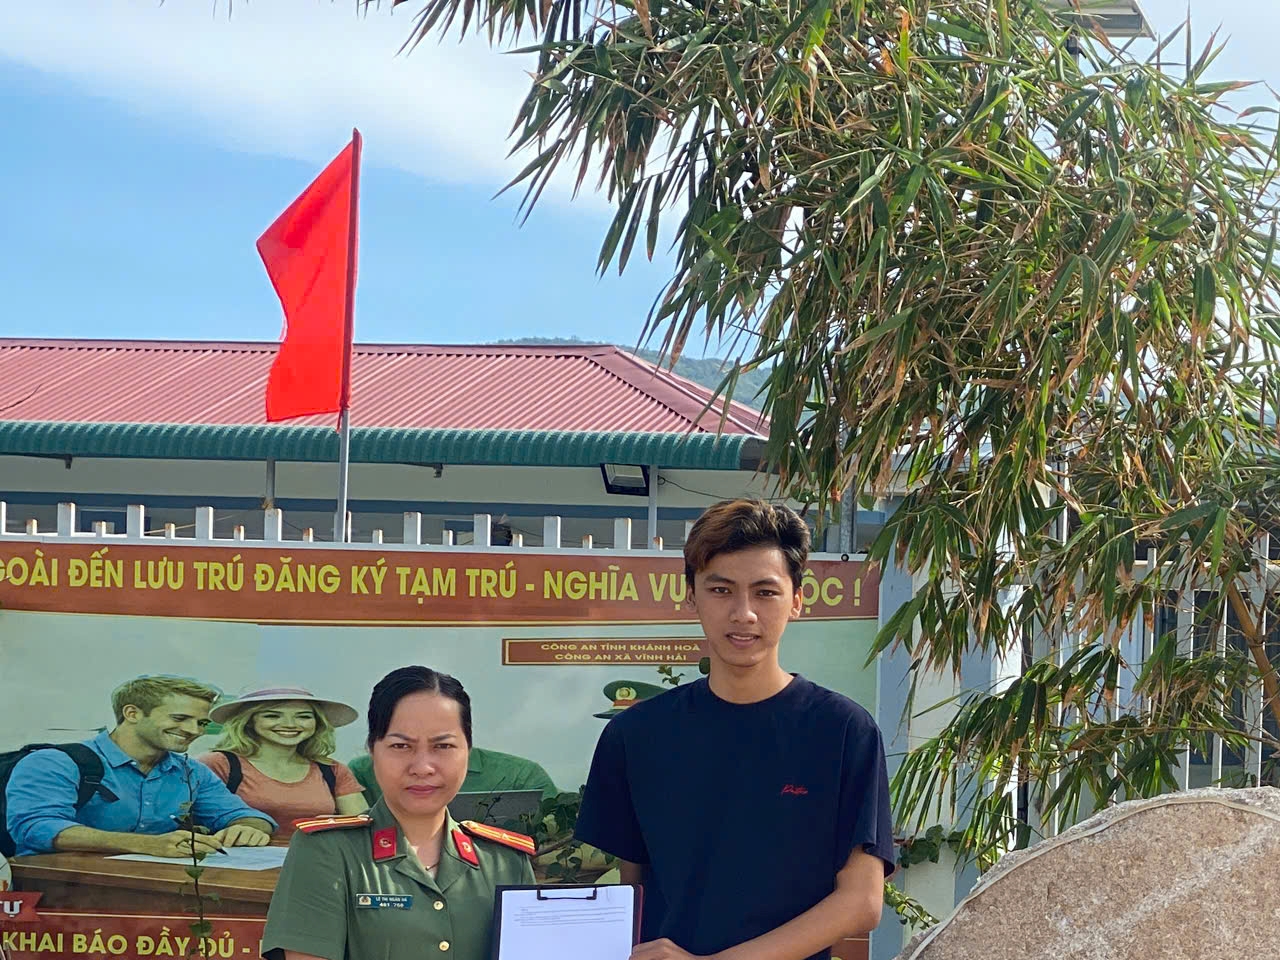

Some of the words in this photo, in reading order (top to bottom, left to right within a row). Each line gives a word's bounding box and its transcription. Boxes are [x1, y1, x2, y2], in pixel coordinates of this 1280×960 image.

[0, 549, 59, 587] OÀI
[68, 547, 124, 588] ĐẾN
[134, 556, 184, 590] LƯU
[193, 554, 244, 592] TRÚ
[254, 557, 341, 594] ĐĂNG
[351, 558, 388, 595] KÝ
[396, 567, 456, 604] TẠM
[465, 561, 518, 598] TRÚ
[543, 565, 639, 601] NGHĨA
[649, 573, 687, 611] VỤ
[801, 568, 844, 614] ỘC
[541, 643, 578, 651] CÔNG
[580, 643, 598, 651] AN
[554, 652, 592, 661] CÔNG
[596, 653, 611, 661] AN
[0, 899, 24, 918] Ự
[3, 931, 63, 953] KHAI
[73, 928, 128, 955] BÁO
[136, 926, 190, 957] ĐẦY
